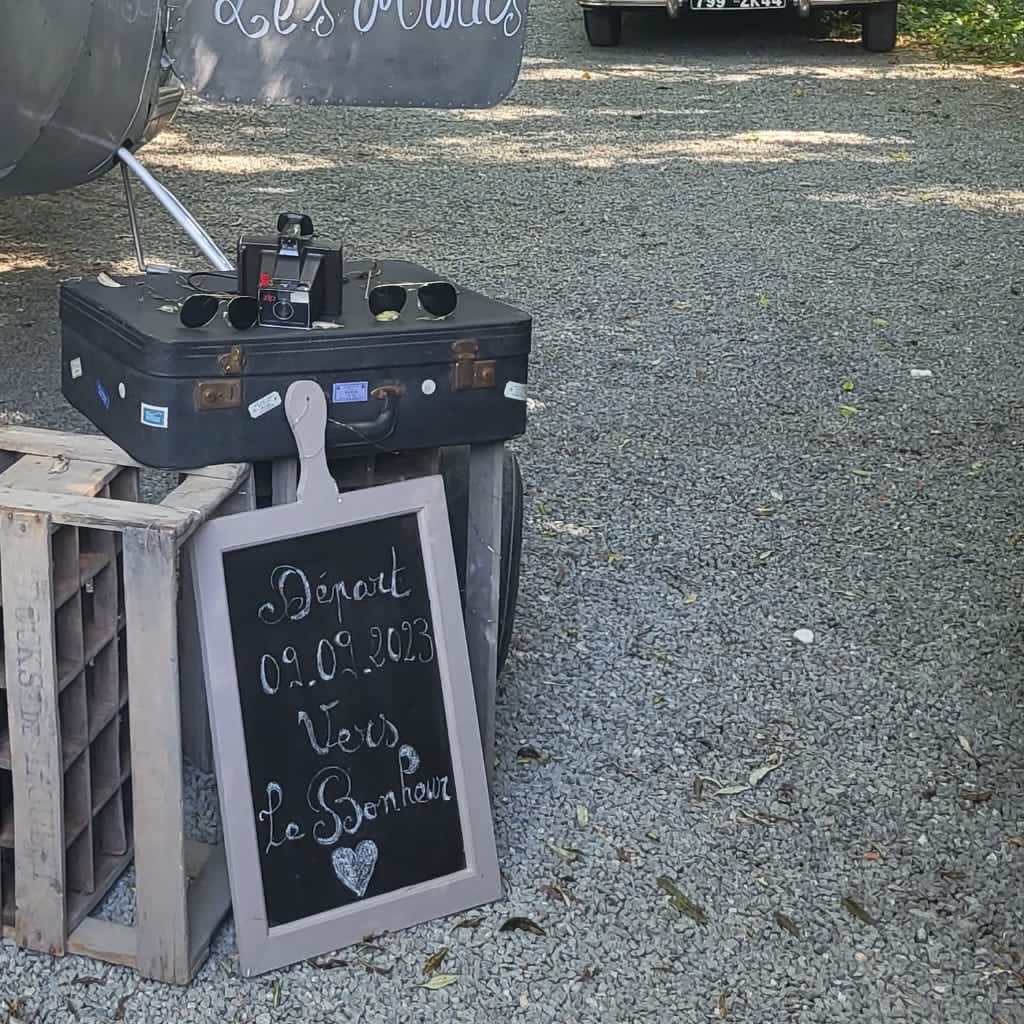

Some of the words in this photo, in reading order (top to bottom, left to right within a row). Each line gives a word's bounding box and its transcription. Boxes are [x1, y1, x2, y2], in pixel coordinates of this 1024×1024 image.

[258, 546, 411, 624] Départ
[260, 617, 434, 694] 09.09.2023
[298, 700, 399, 755] Vers
[259, 781, 306, 854] Le
[307, 744, 451, 845] Bonheur
